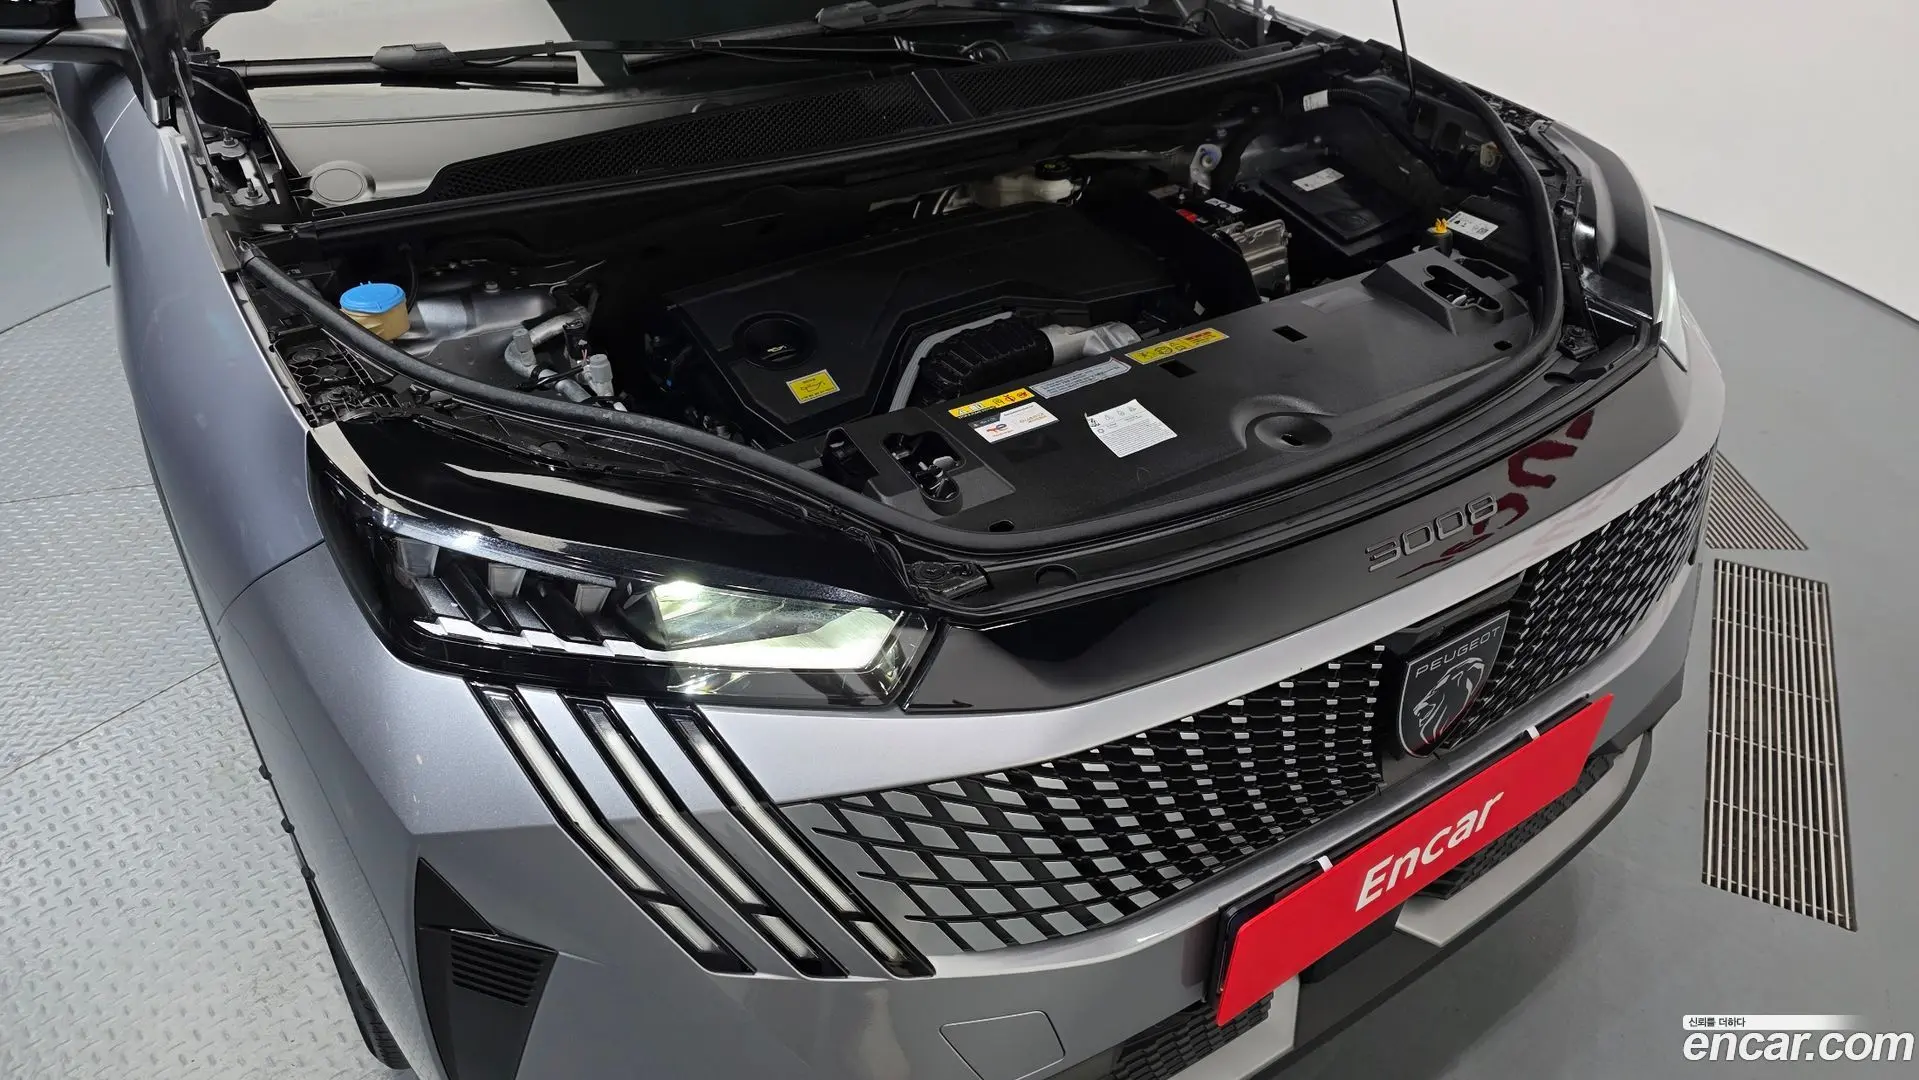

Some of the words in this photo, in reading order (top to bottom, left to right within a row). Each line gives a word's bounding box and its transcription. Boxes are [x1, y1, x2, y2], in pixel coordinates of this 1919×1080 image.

[1365, 493, 1498, 573] 3008
[1415, 626, 1501, 678] PEUGEOT
[1355, 791, 1504, 912] Encar
